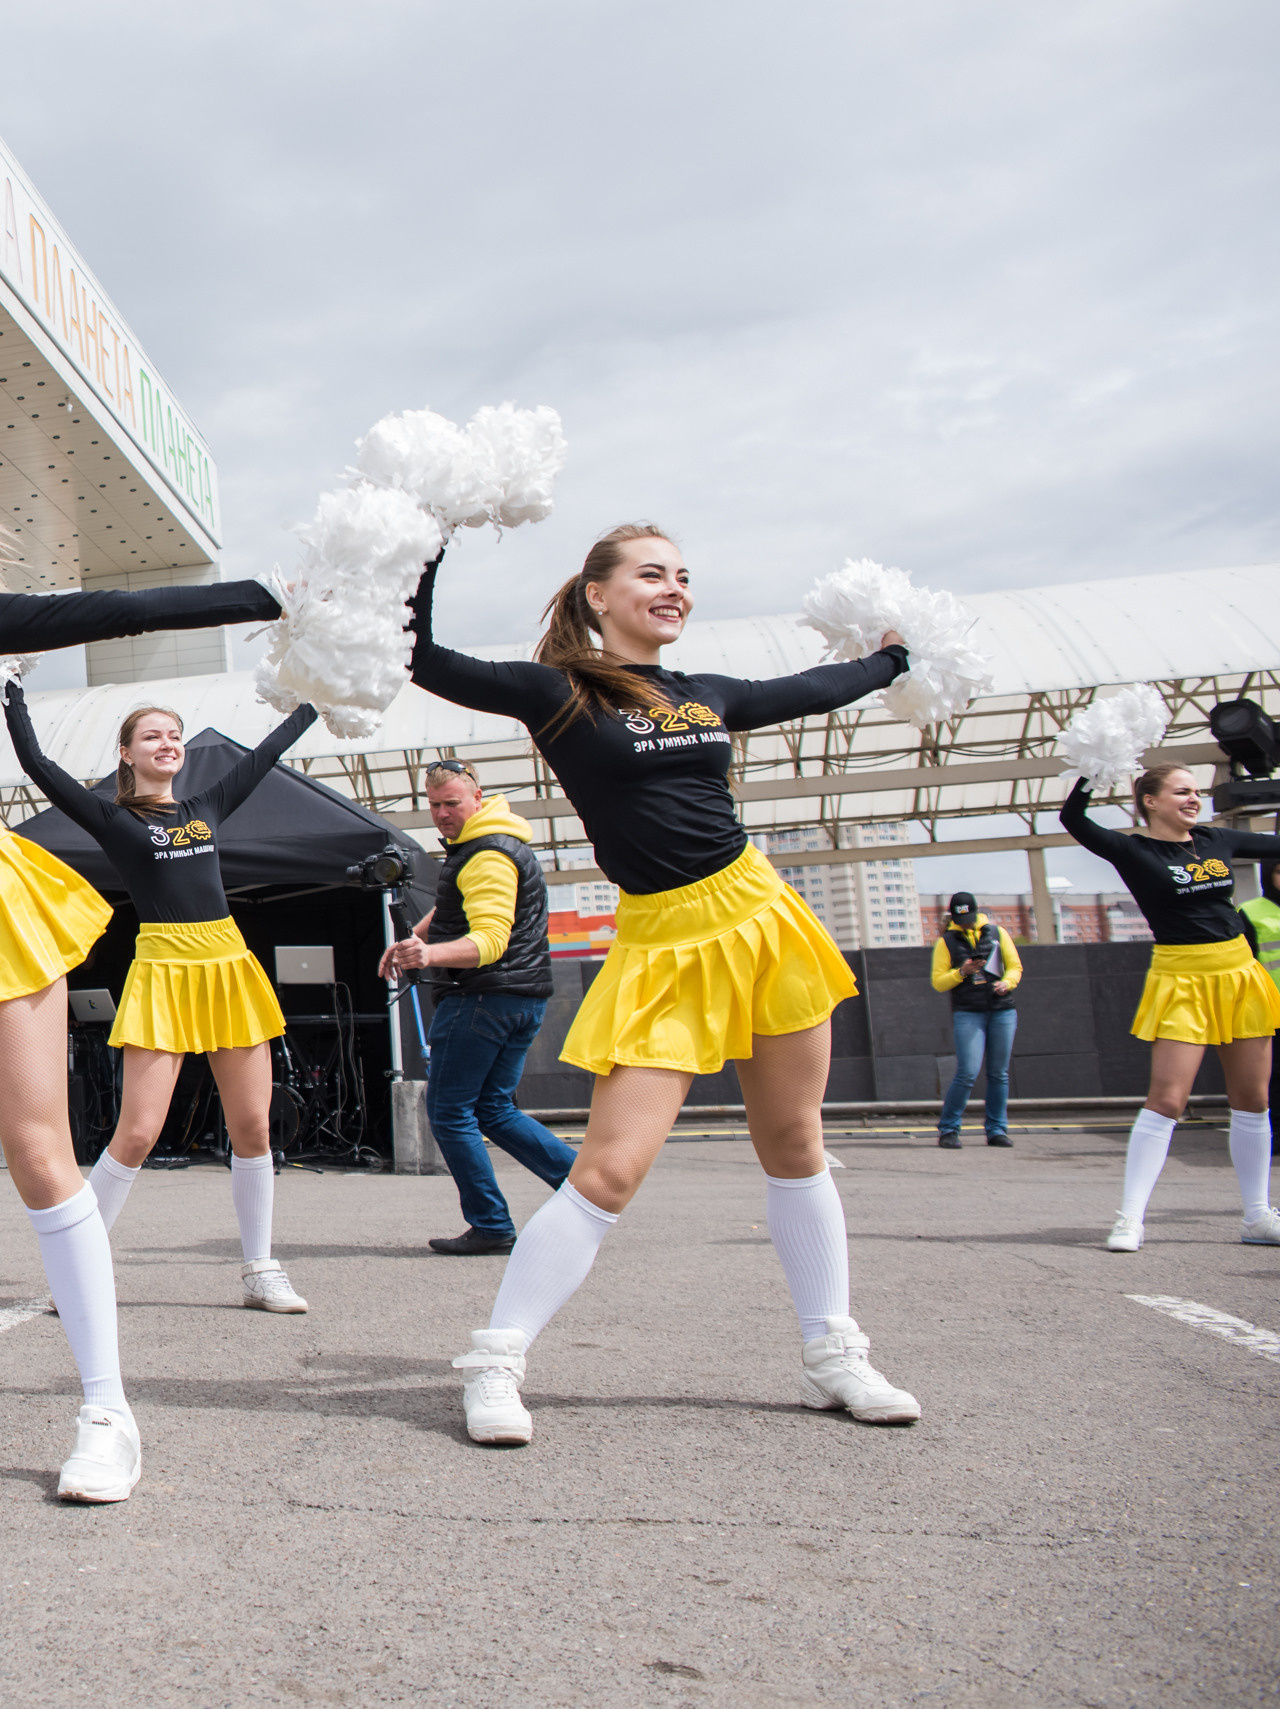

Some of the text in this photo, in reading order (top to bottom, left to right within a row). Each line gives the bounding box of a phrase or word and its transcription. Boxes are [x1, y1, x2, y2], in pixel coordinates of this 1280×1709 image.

[29, 213, 136, 429] ПЛАНЕТА
[140, 368, 215, 528] ПЛАНЕТА
[634, 741, 655, 753] ЭРА
[656, 734, 698, 750] УМНЫХ
[154, 851, 168, 859] ЭРА
[169, 849, 194, 859] УМНЫХ
